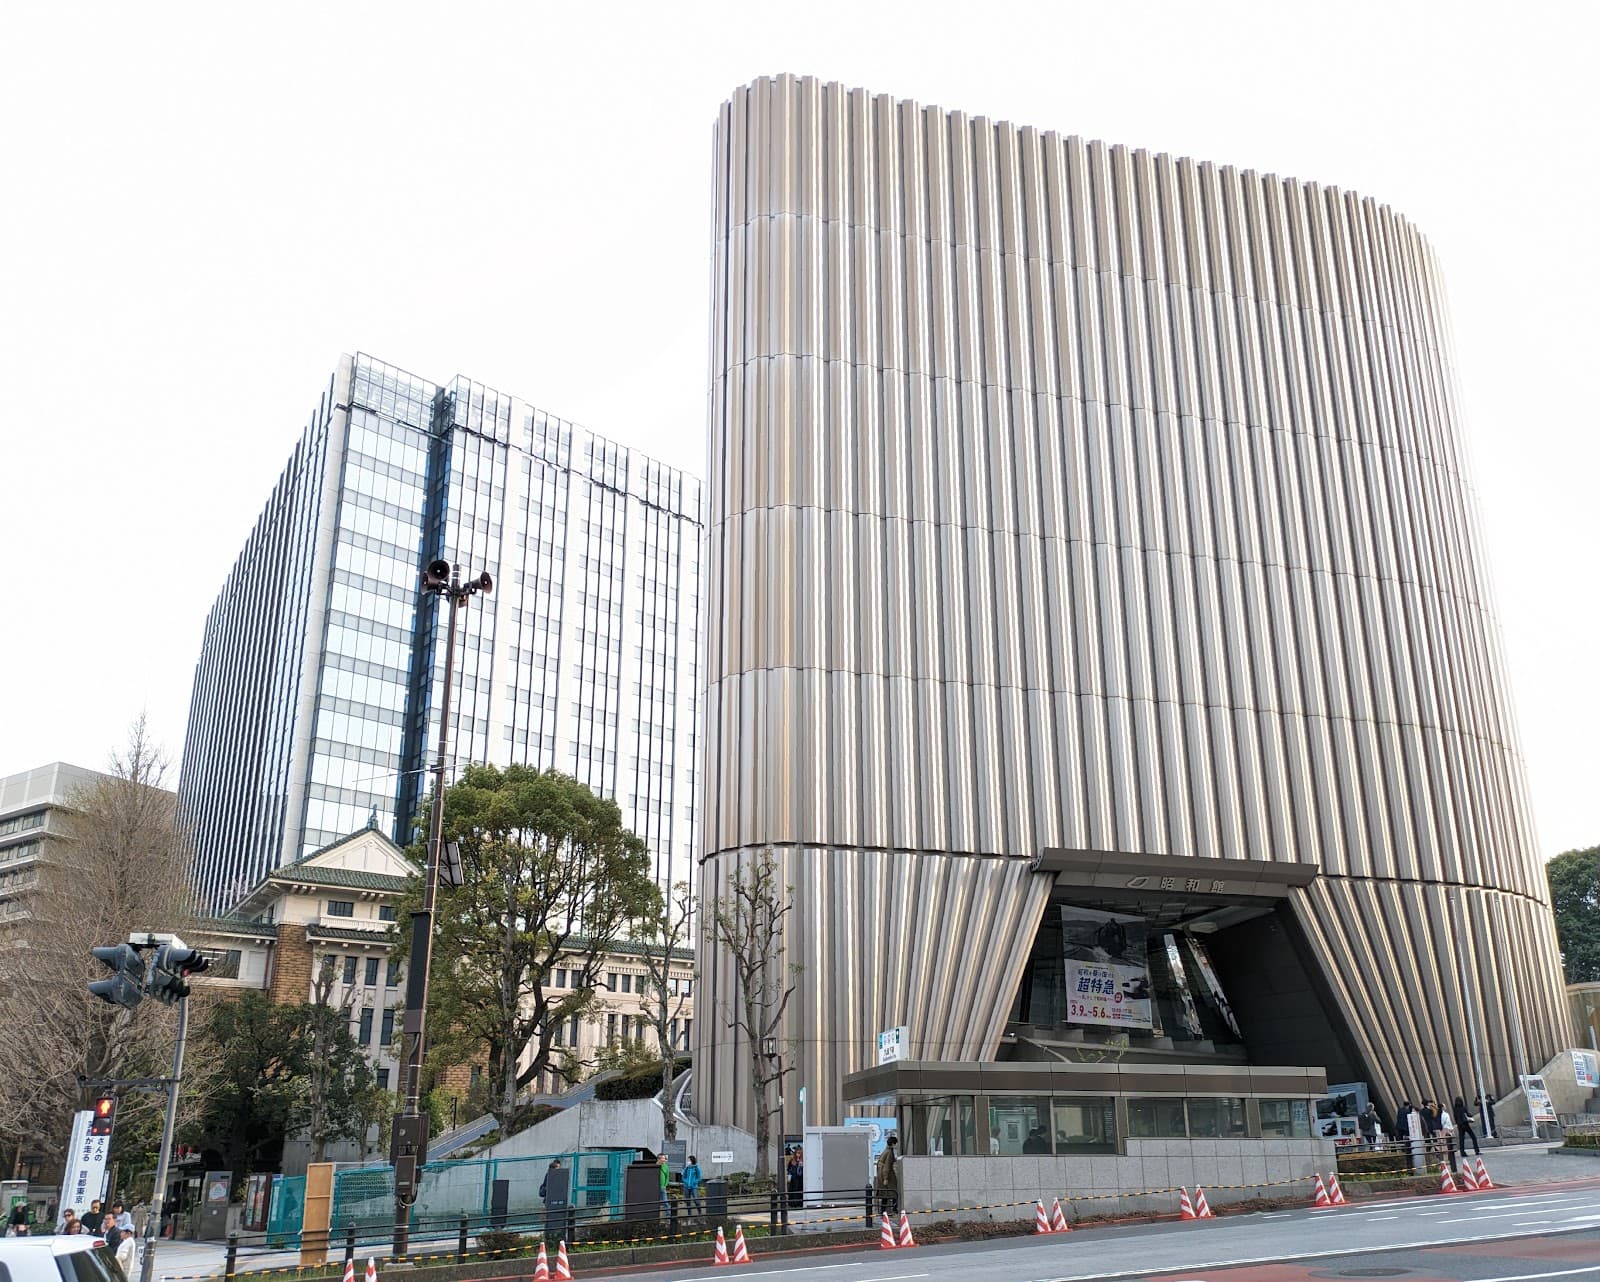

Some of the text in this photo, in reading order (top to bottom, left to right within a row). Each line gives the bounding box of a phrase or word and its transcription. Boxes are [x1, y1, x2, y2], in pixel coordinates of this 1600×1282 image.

[1161, 877, 1225, 893] 昭和館
[1077, 976, 1115, 995] 超特急
[74, 1170, 88, 1204] 首都東京
